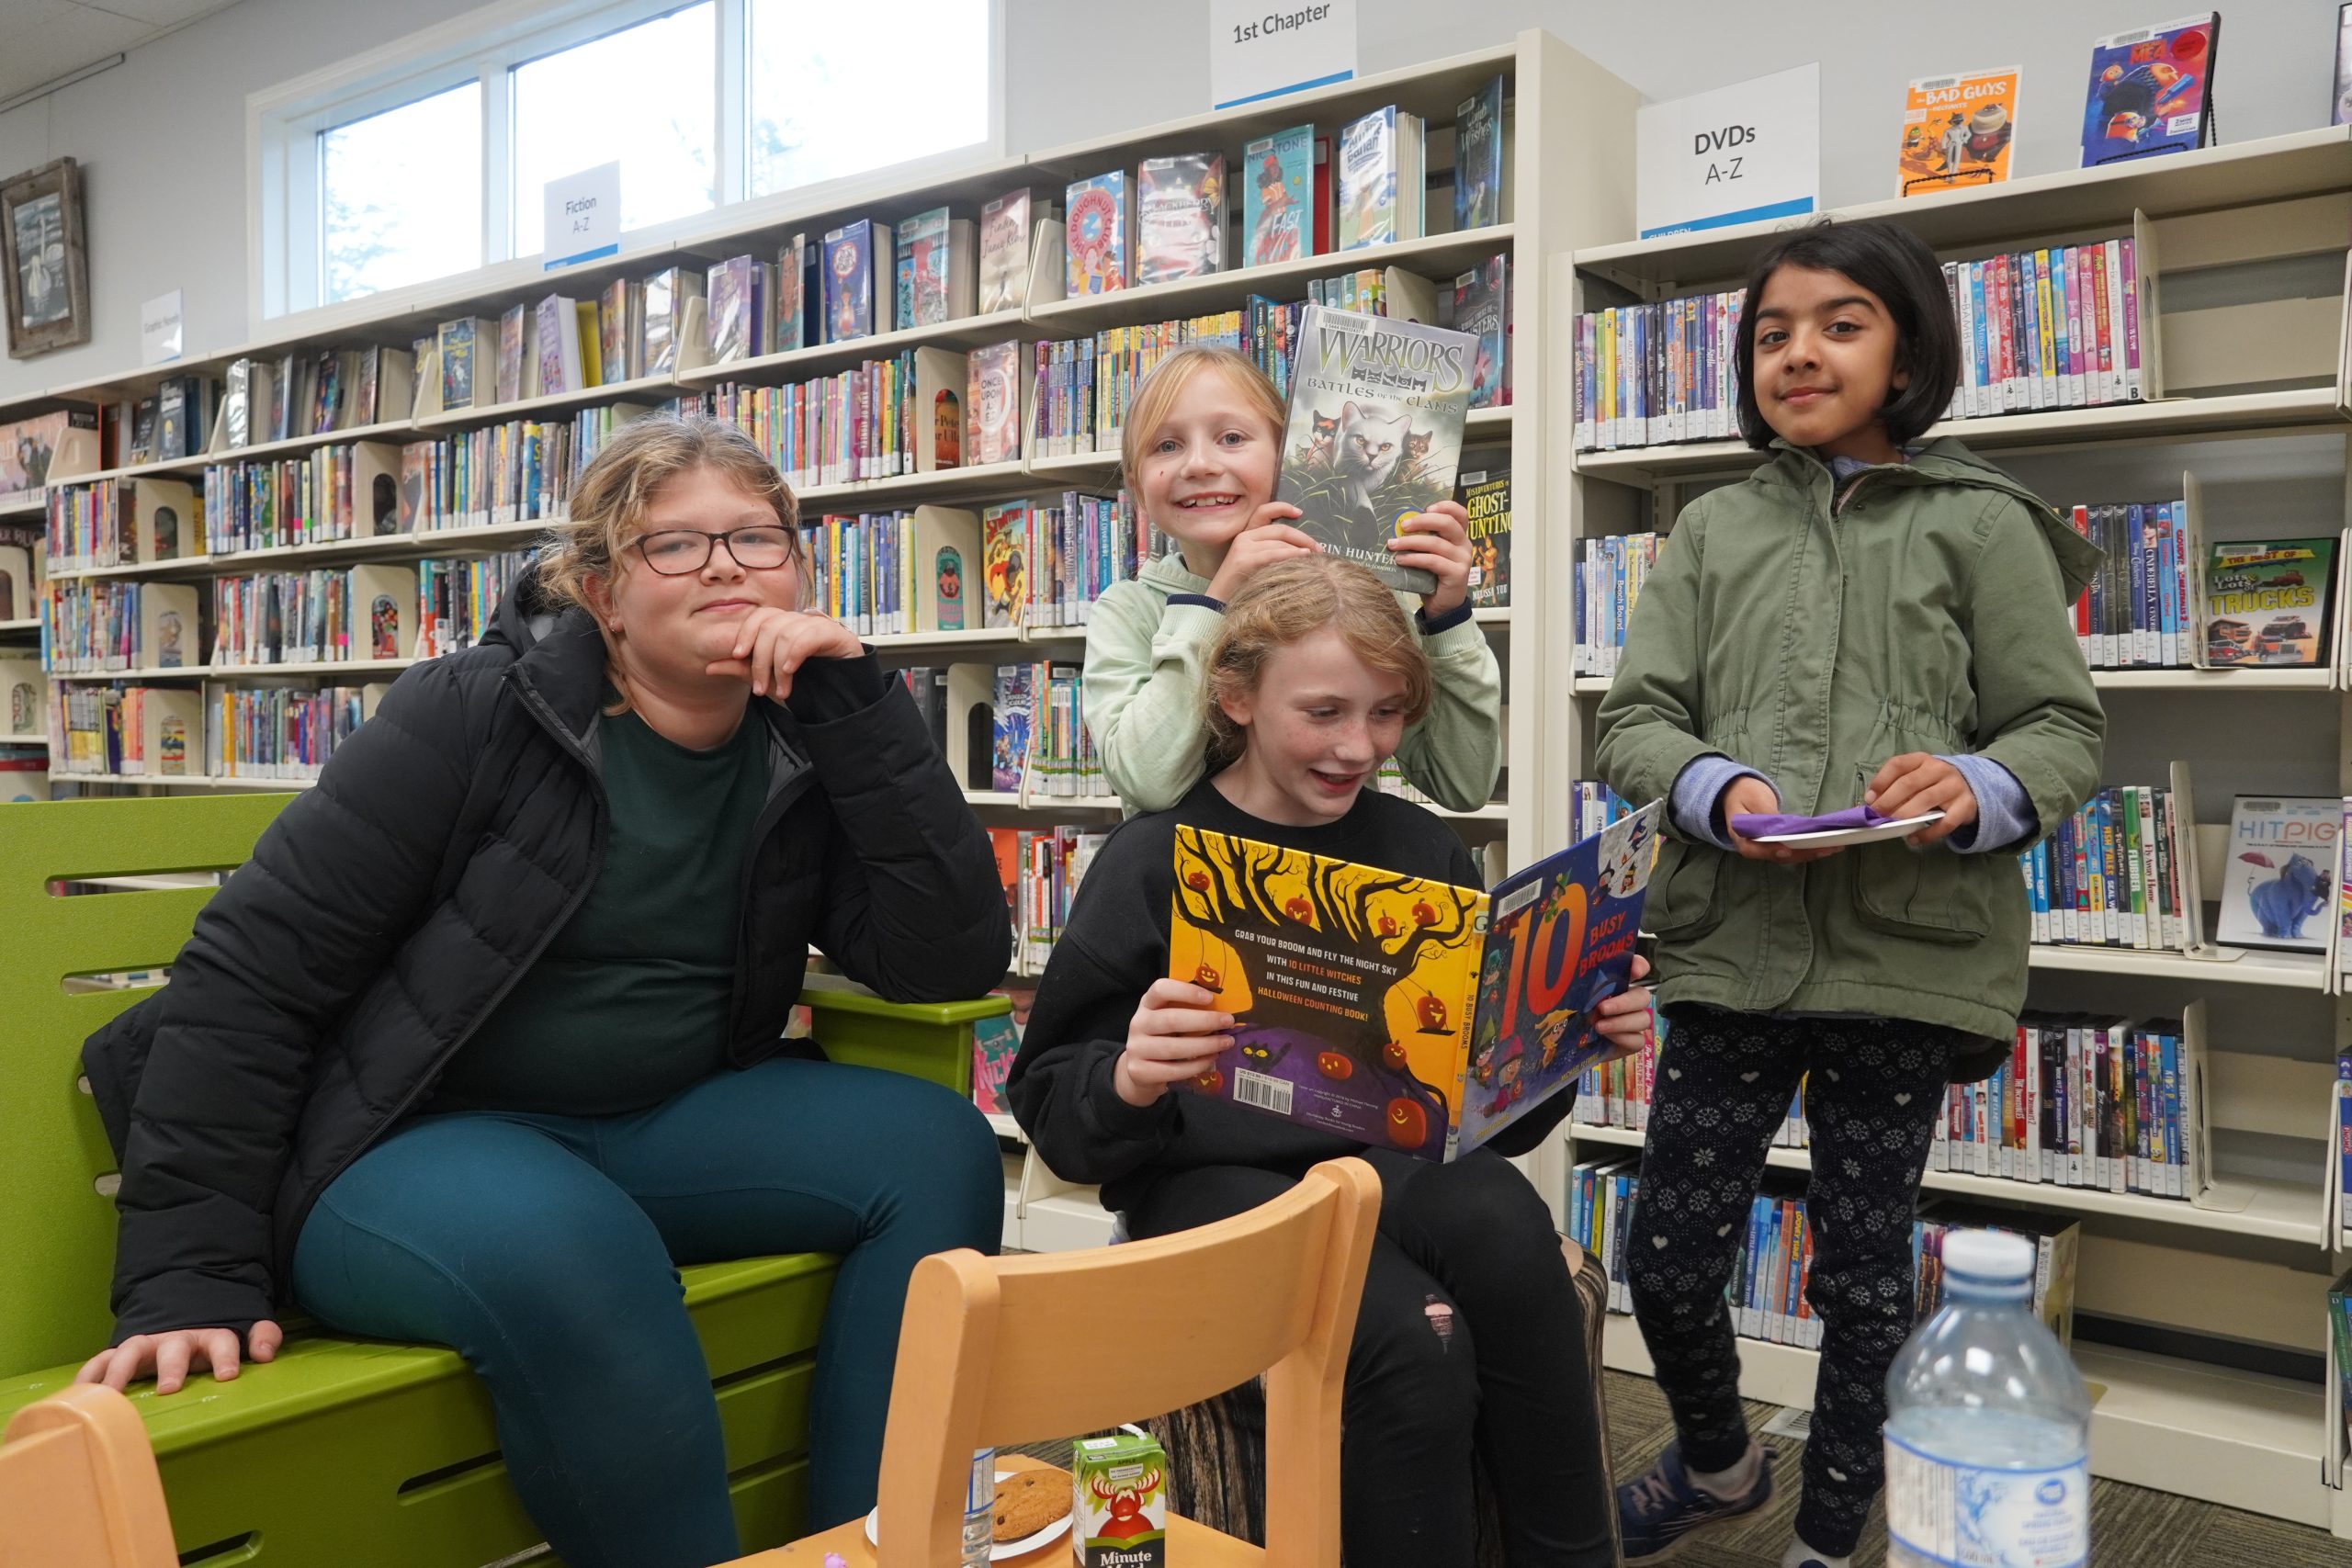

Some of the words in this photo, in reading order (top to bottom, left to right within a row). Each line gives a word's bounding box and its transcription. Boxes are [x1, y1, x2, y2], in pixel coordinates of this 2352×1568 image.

[1233, 23, 1258, 44] 1st
[1262, 2, 1330, 34] Chapter
[1926, 89, 1961, 105] BAD
[1963, 81, 2007, 100] GUYS
[1272, 138, 1308, 155] STONE
[1694, 125, 1756, 155] DVDs
[1704, 157, 1743, 185] A-Z
[566, 197, 596, 216] Fiction
[1071, 196, 1111, 231] DOUGHNUT
[572, 217, 590, 234] A-Z
[1271, 209, 1304, 235] FAST
[1961, 304, 1970, 344] BAMBI
[1319, 327, 1463, 392] WARRIORS
[981, 377, 1001, 389] ONCE
[981, 389, 1001, 400] UPON
[1307, 376, 1374, 399] BATTLES
[1406, 394, 1458, 414] CLANS
[2131, 388, 2139, 399] B
[1466, 479, 1504, 498] MISADVENTURES
[1467, 491, 1509, 519] GHOST-
[1320, 541, 1341, 557] RIN
[1345, 544, 1397, 566] HUNTER
[2227, 557, 2245, 565] THE
[2132, 558, 2142, 587] Cinderella
[2146, 549, 2155, 603] CINDERELLA
[2214, 574, 2247, 583] Lots
[2217, 581, 2251, 590] Lots
[1473, 585, 1495, 600] MELISSA
[1496, 584, 1508, 594] YUE
[2209, 586, 2314, 615] TRUCKS
[2102, 826, 2112, 846] FISH
[2104, 849, 2114, 875] TALES
[2144, 844, 2154, 856] Fly
[2128, 850, 2141, 892] FLUBBER
[2145, 859, 2154, 877] Away
[2107, 881, 2115, 898] SEAL
[2146, 879, 2156, 902] Home
[1475, 917, 1487, 931] G
[1589, 912, 1626, 947] BUSY
[1235, 930, 1254, 942] GRAB
[1256, 933, 1277, 947] YOUR
[1278, 938, 1306, 954] BROOM
[1306, 944, 1322, 958] AND
[1324, 948, 1338, 961] FLY
[1340, 952, 1354, 965] THE
[1355, 956, 1380, 972] NIGHT
[1382, 964, 1397, 976] SKY
[1499, 882, 1588, 1043] 10
[1579, 931, 1634, 977] BROOMS
[1266, 953, 1287, 967] WITH
[1288, 958, 1297, 968] 10
[1298, 960, 1325, 976] LITTLE
[1327, 966, 1362, 986] WITCHES
[1266, 971, 1274, 981] IN
[1276, 973, 1294, 986] THIS
[1295, 976, 1310, 989] FUN
[1312, 980, 1328, 994] AND
[1329, 985, 1359, 1002] FESTIVE
[1258, 986, 1303, 1007] HALLOWEEN
[1304, 995, 1343, 1016] COUNTING
[1344, 1005, 1368, 1021] BOOK!
[1461, 1023, 1470, 1050] BROOMS
[2015, 1078, 2024, 1087] THE
[2015, 1088, 2024, 1119] INCREDIBLES
[1793, 1211, 1803, 1238] LOONEY
[1792, 1240, 1800, 1261] TUNES
[1101, 1551, 1152, 1566] Minute
